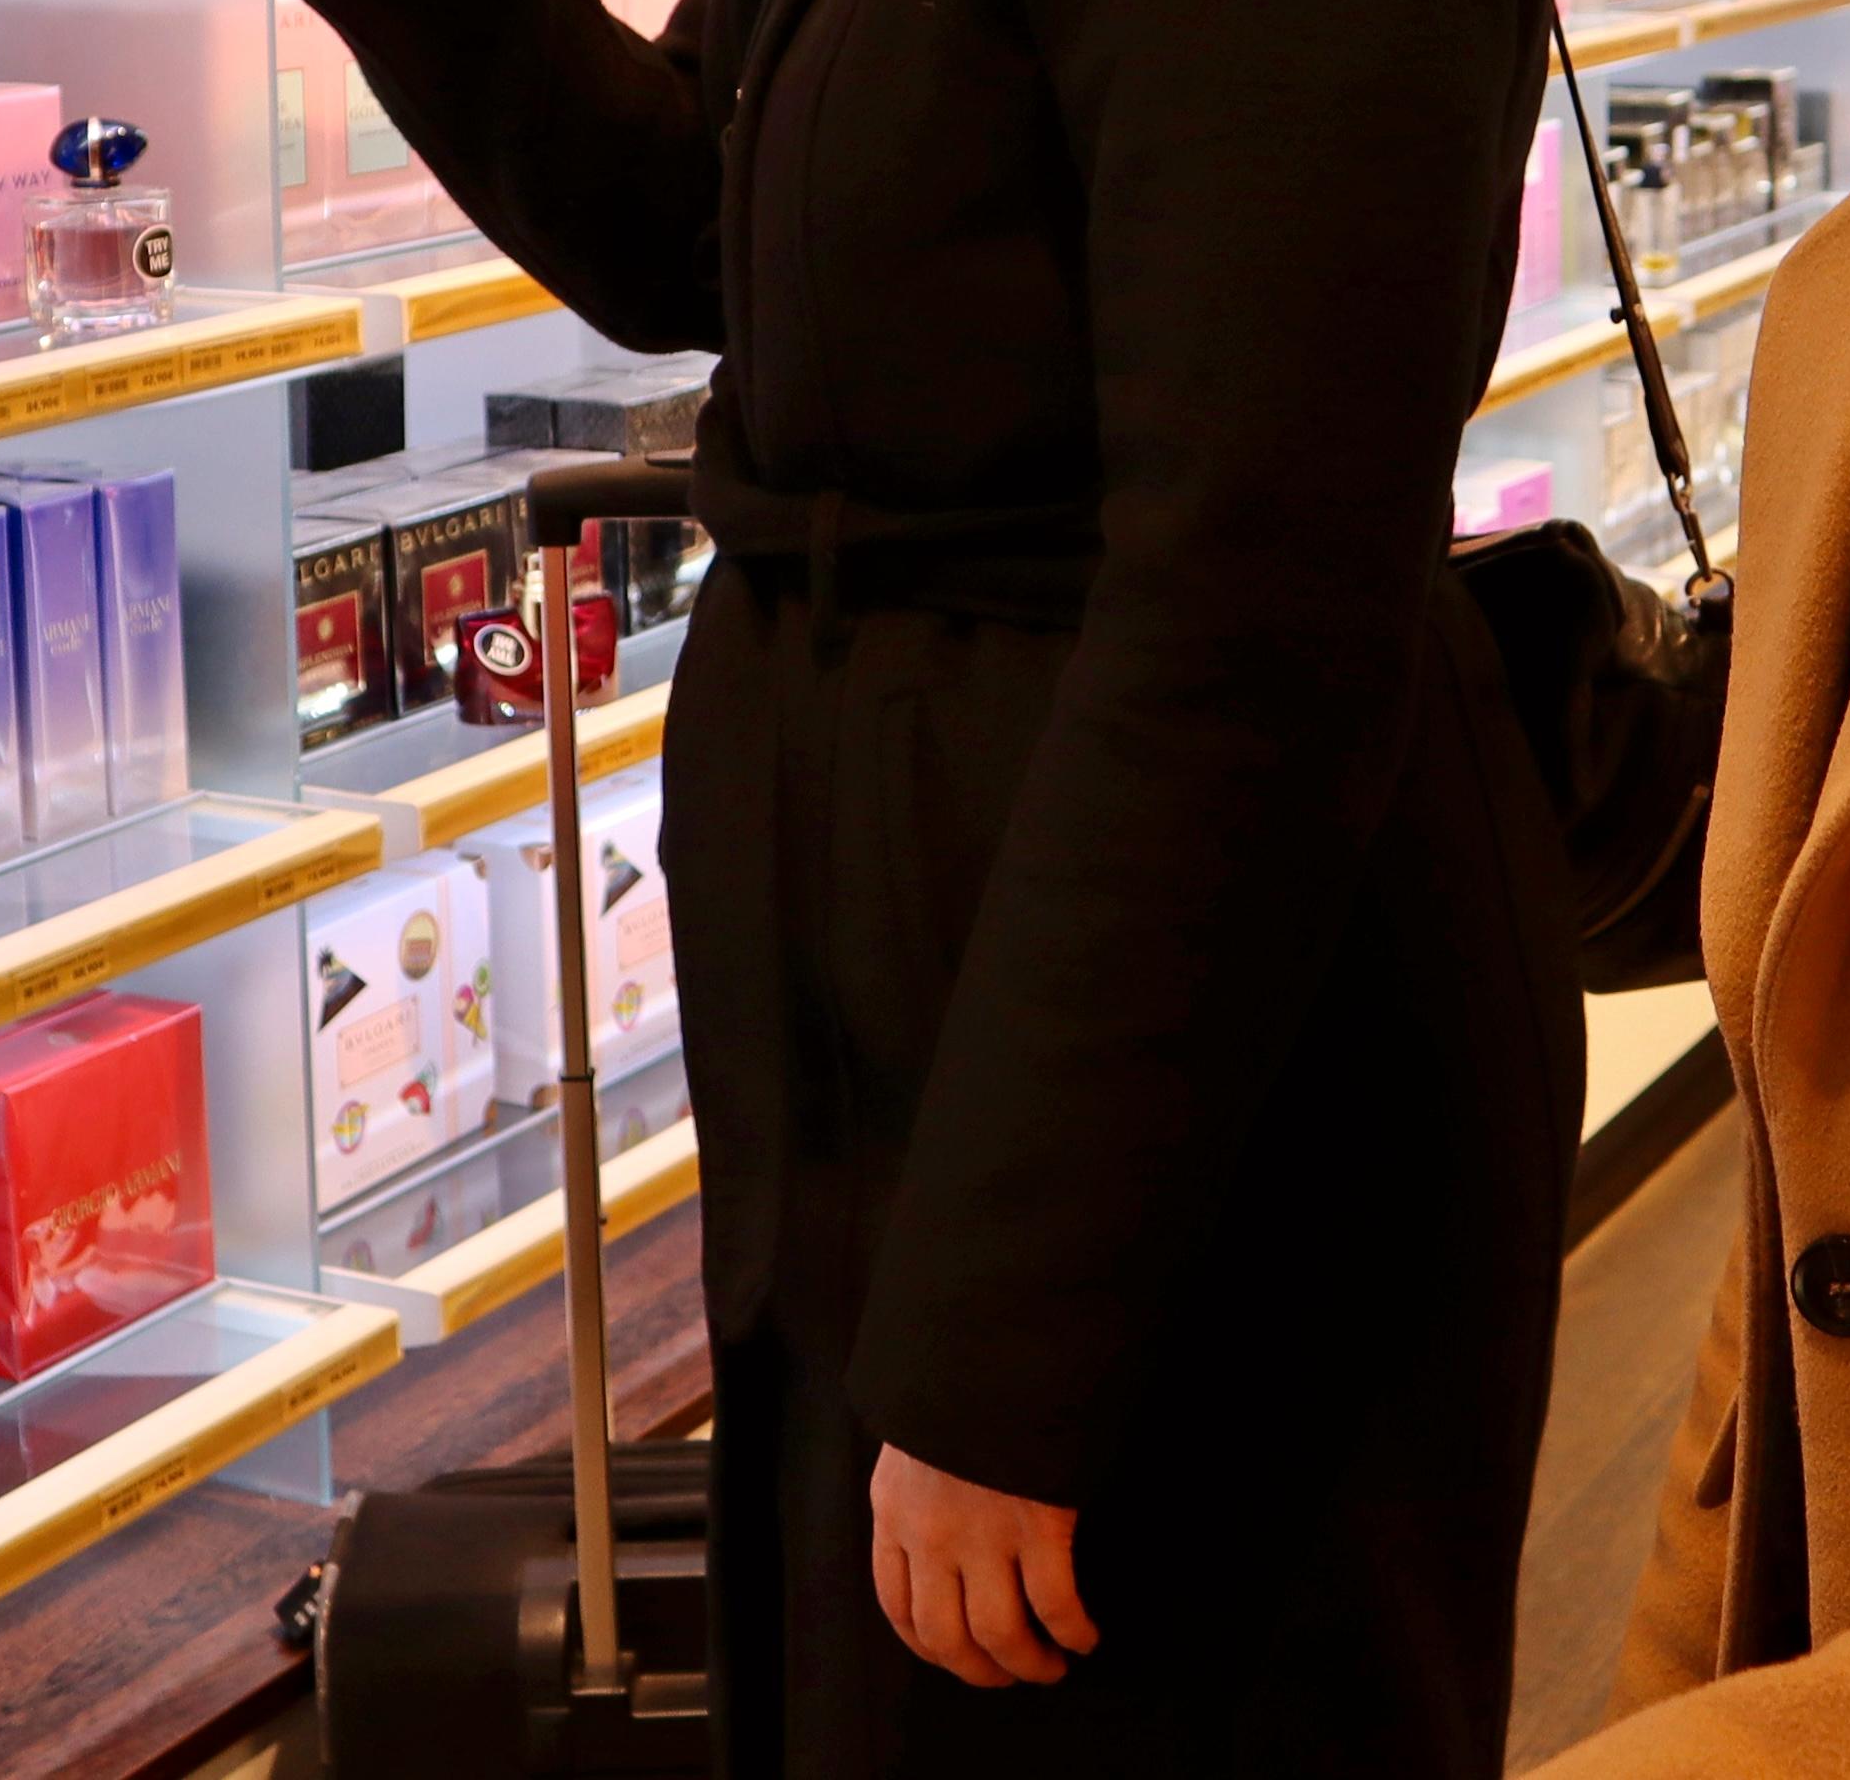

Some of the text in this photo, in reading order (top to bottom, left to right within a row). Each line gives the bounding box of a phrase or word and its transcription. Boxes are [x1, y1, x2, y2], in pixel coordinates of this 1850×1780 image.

[12, 170, 51, 190] WAY
[144, 236, 169, 256] TRY
[148, 252, 171, 272] ME
[399, 505, 503, 553] BVLGARI
